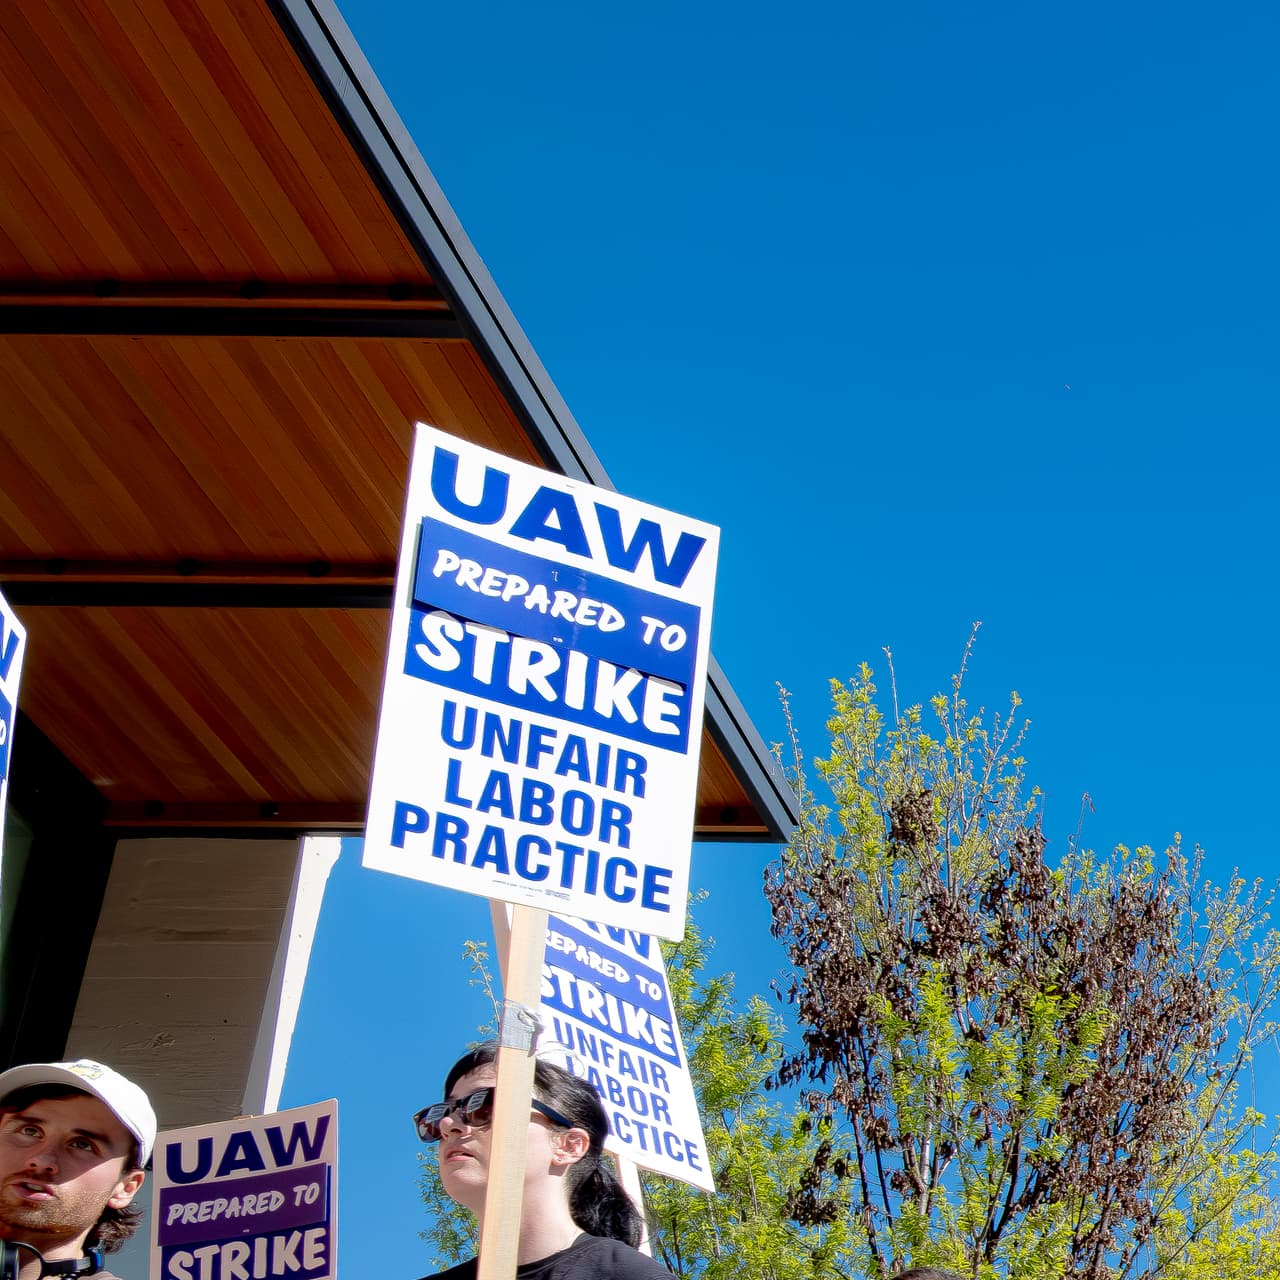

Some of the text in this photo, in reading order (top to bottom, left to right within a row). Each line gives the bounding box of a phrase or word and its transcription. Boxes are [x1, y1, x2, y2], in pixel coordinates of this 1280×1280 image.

[430, 445, 707, 588] UAW
[432, 548, 687, 652] PREPARED TO
[415, 609, 682, 737] STRIKE
[440, 699, 648, 799] UNFAIR
[444, 759, 633, 850] LABOR
[389, 799, 673, 913] PRACTICE
[545, 929, 629, 983] REPARED
[635, 974, 662, 1001] TO
[552, 1017, 670, 1094] UNFAIR
[165, 1114, 332, 1185] UAW
[167, 1182, 320, 1226] PREPARED TO
